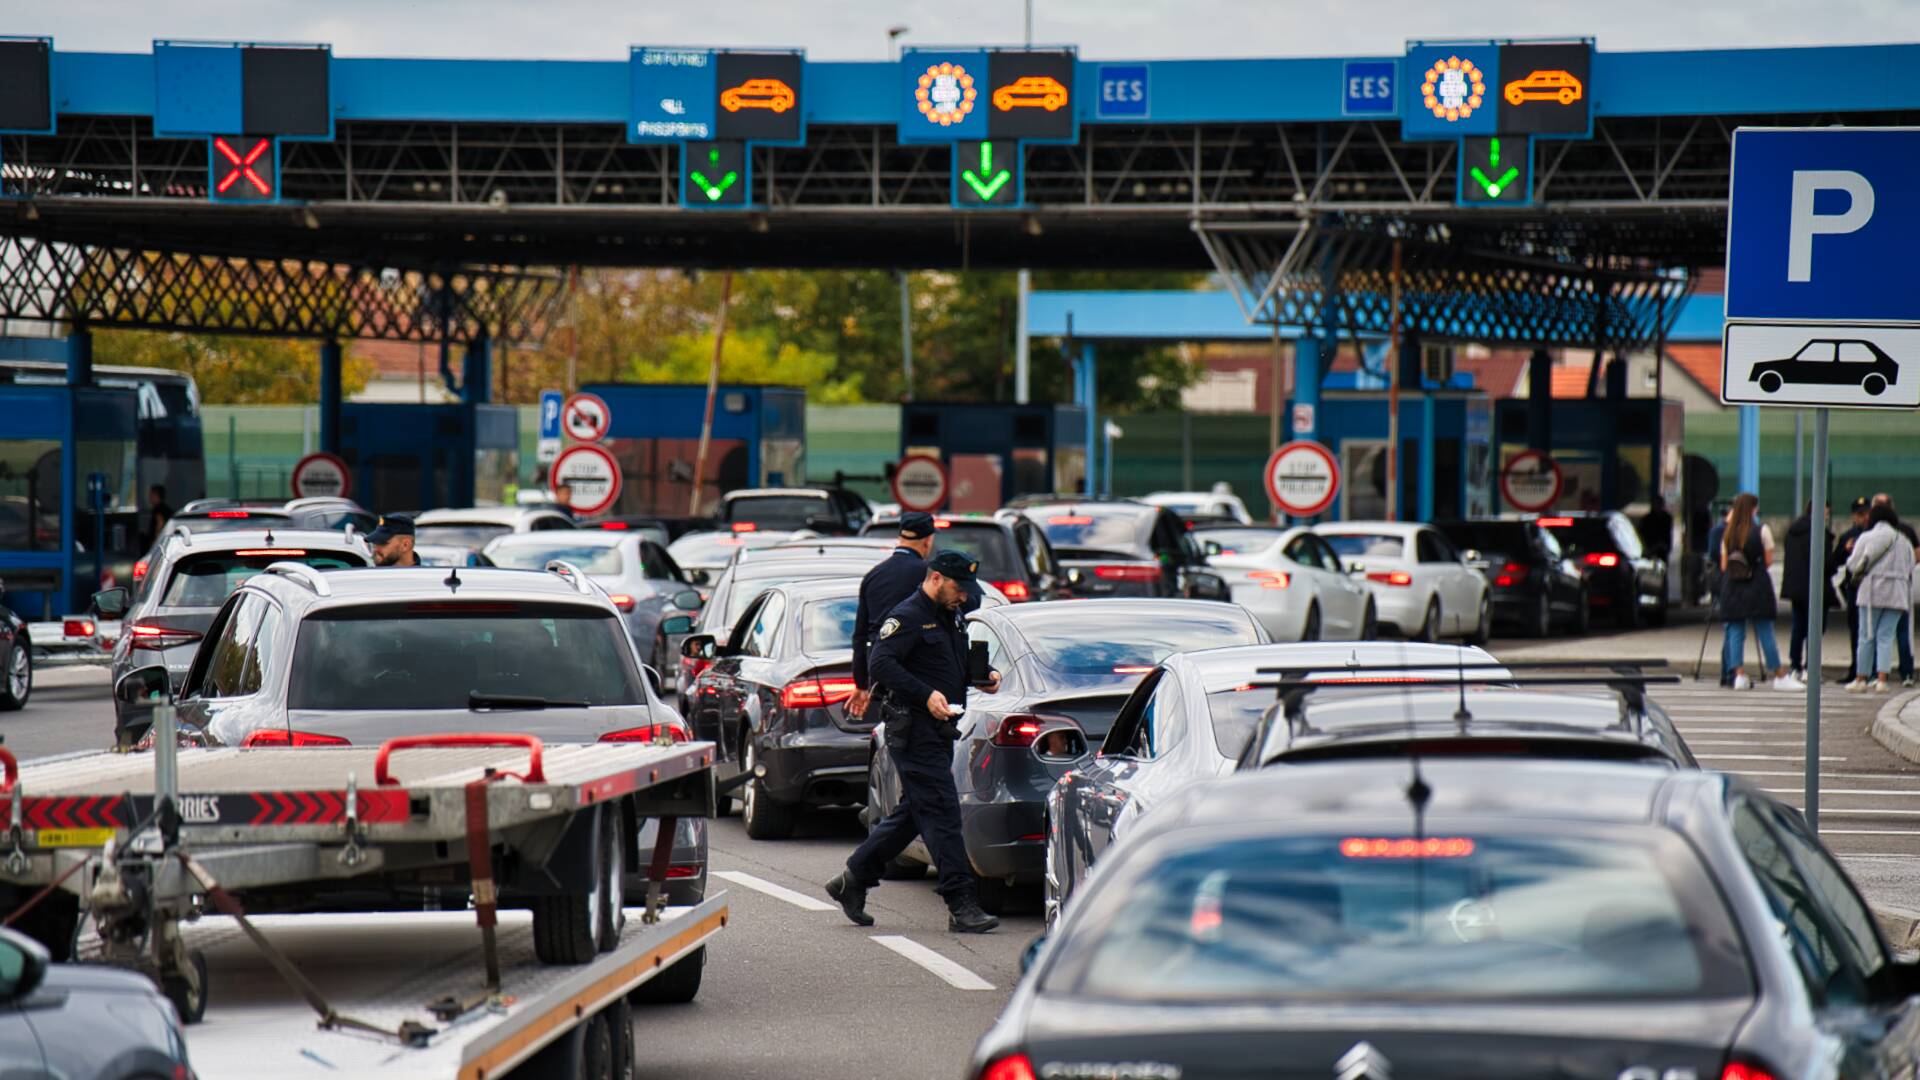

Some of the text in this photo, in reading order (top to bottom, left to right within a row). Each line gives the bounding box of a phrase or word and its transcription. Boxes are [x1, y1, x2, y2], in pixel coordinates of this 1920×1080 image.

[1104, 80, 1143, 102] EES
[1349, 77, 1391, 99] EES
[1787, 170, 1875, 282] P
[544, 399, 558, 432] P
